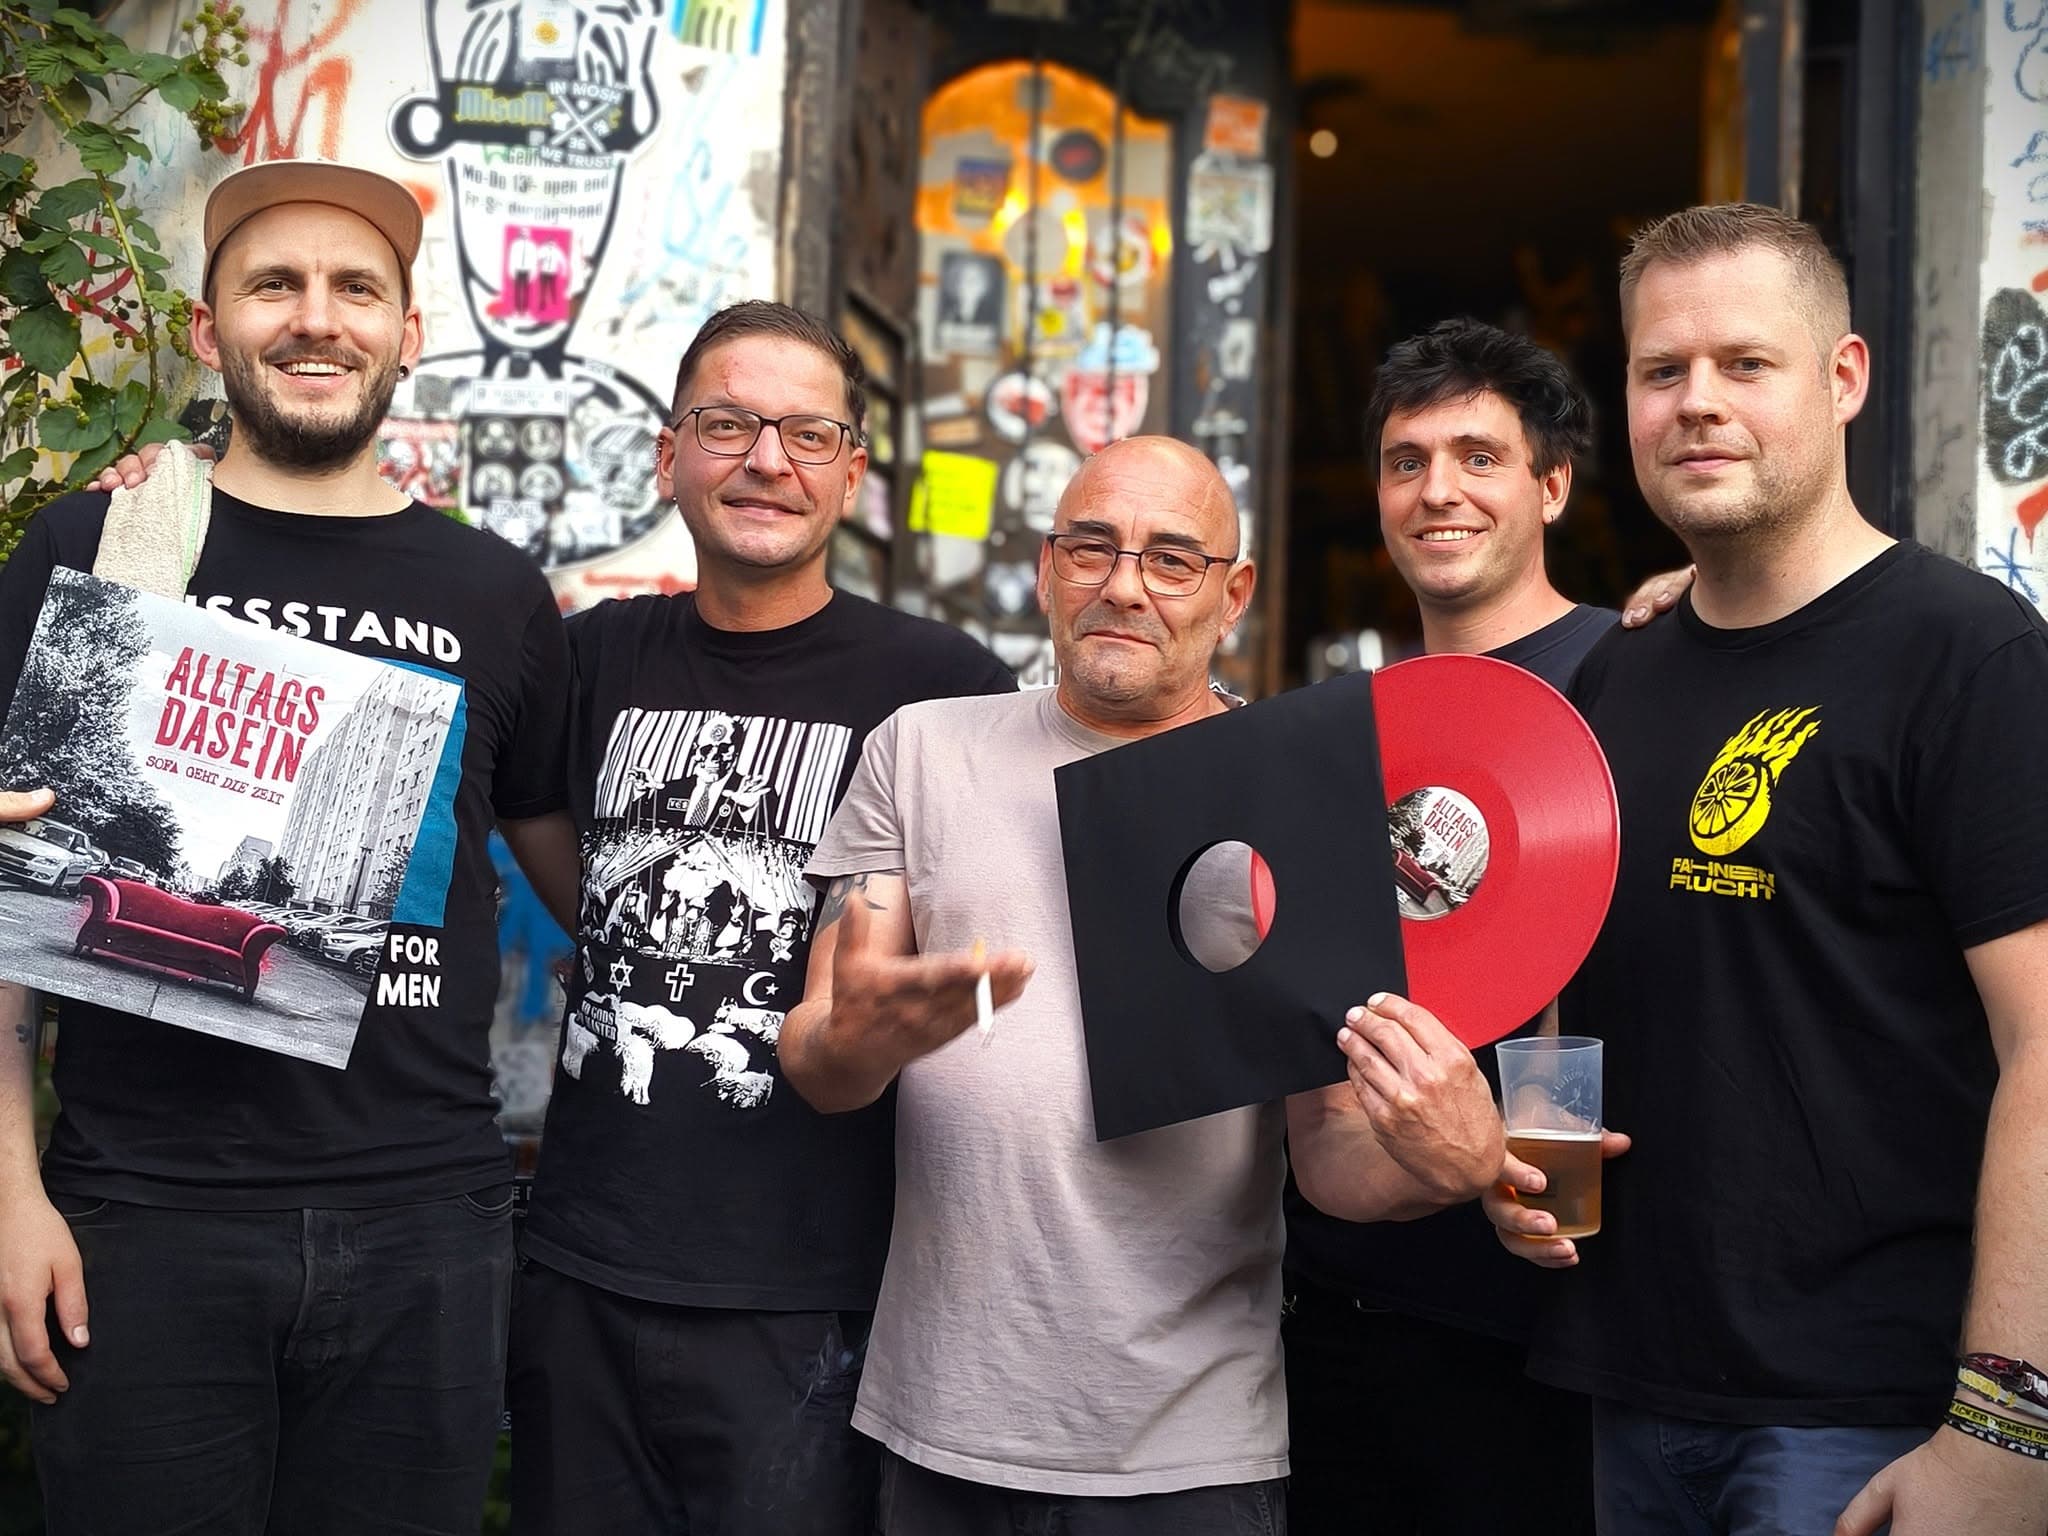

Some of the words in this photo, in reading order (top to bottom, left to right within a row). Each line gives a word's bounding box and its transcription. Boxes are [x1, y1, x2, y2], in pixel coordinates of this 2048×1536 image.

[548, 82, 567, 95] IN
[572, 83, 621, 104] MOSH
[540, 145, 563, 162] WE
[567, 153, 616, 172] TRUST
[544, 179, 578, 198] open
[584, 173, 609, 190] end
[165, 646, 326, 736] ALLTAGS
[154, 696, 307, 783] DASEIN
[145, 755, 179, 775] SOFA
[185, 766, 220, 787] GEHT
[220, 776, 250, 795] DIE
[251, 786, 285, 806] ZEIT
[1423, 810, 1468, 852] DASEIN
[1433, 795, 1479, 841] ALLTAGS
[1669, 873, 1777, 901] FLUCHT
[1671, 857, 1776, 888] FAHNEN
[390, 933, 441, 967] FOR
[376, 973, 442, 1008] MEN
[591, 1006, 615, 1026] GODS
